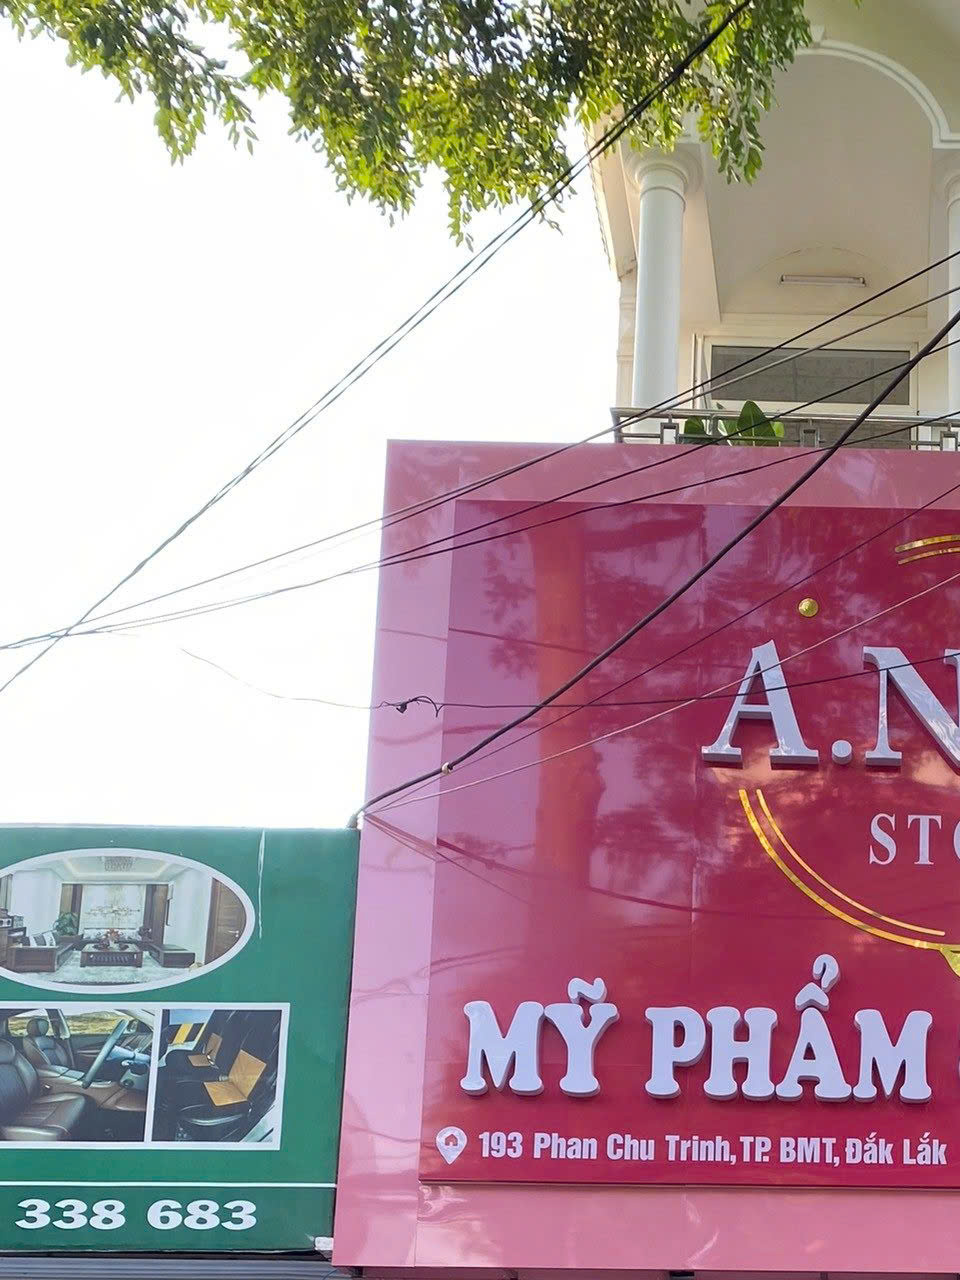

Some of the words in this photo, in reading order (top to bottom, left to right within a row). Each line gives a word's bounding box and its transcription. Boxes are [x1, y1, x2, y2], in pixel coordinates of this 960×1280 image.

[460, 977, 619, 1096] MỸ
[645, 954, 933, 1101] PHẨM
[479, 1131, 523, 1159] 193
[533, 1132, 598, 1161] Phan
[606, 1132, 655, 1162] Chu
[845, 1132, 894, 1165] Đắk
[903, 1132, 948, 1166] Lắk
[15, 1199, 126, 1230] 338
[147, 1199, 257, 1230] 683
